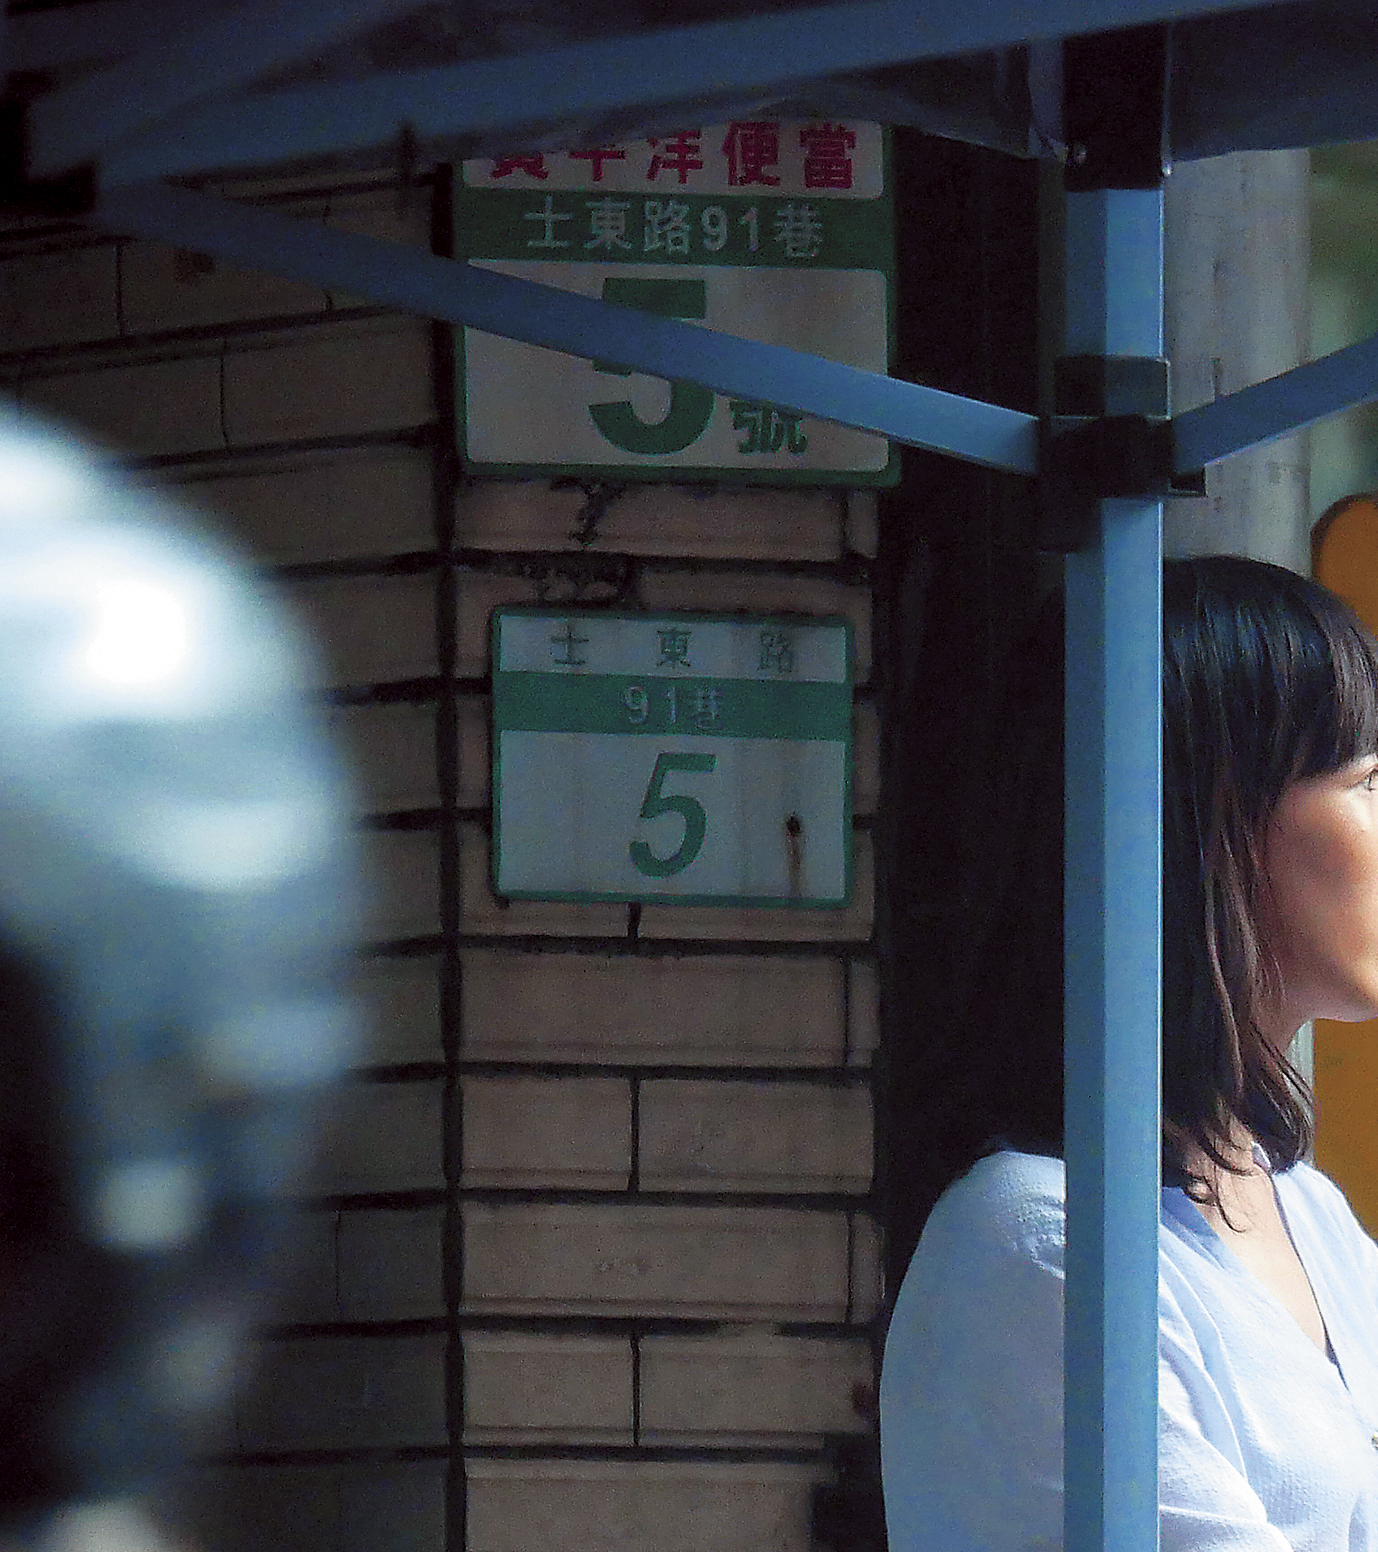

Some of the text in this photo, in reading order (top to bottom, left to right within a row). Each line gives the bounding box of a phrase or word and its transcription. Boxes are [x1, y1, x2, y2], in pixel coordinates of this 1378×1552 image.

[524, 196, 824, 258] 士東路91巷
[550, 625, 794, 673] 士東路
[628, 751, 718, 880] 5
